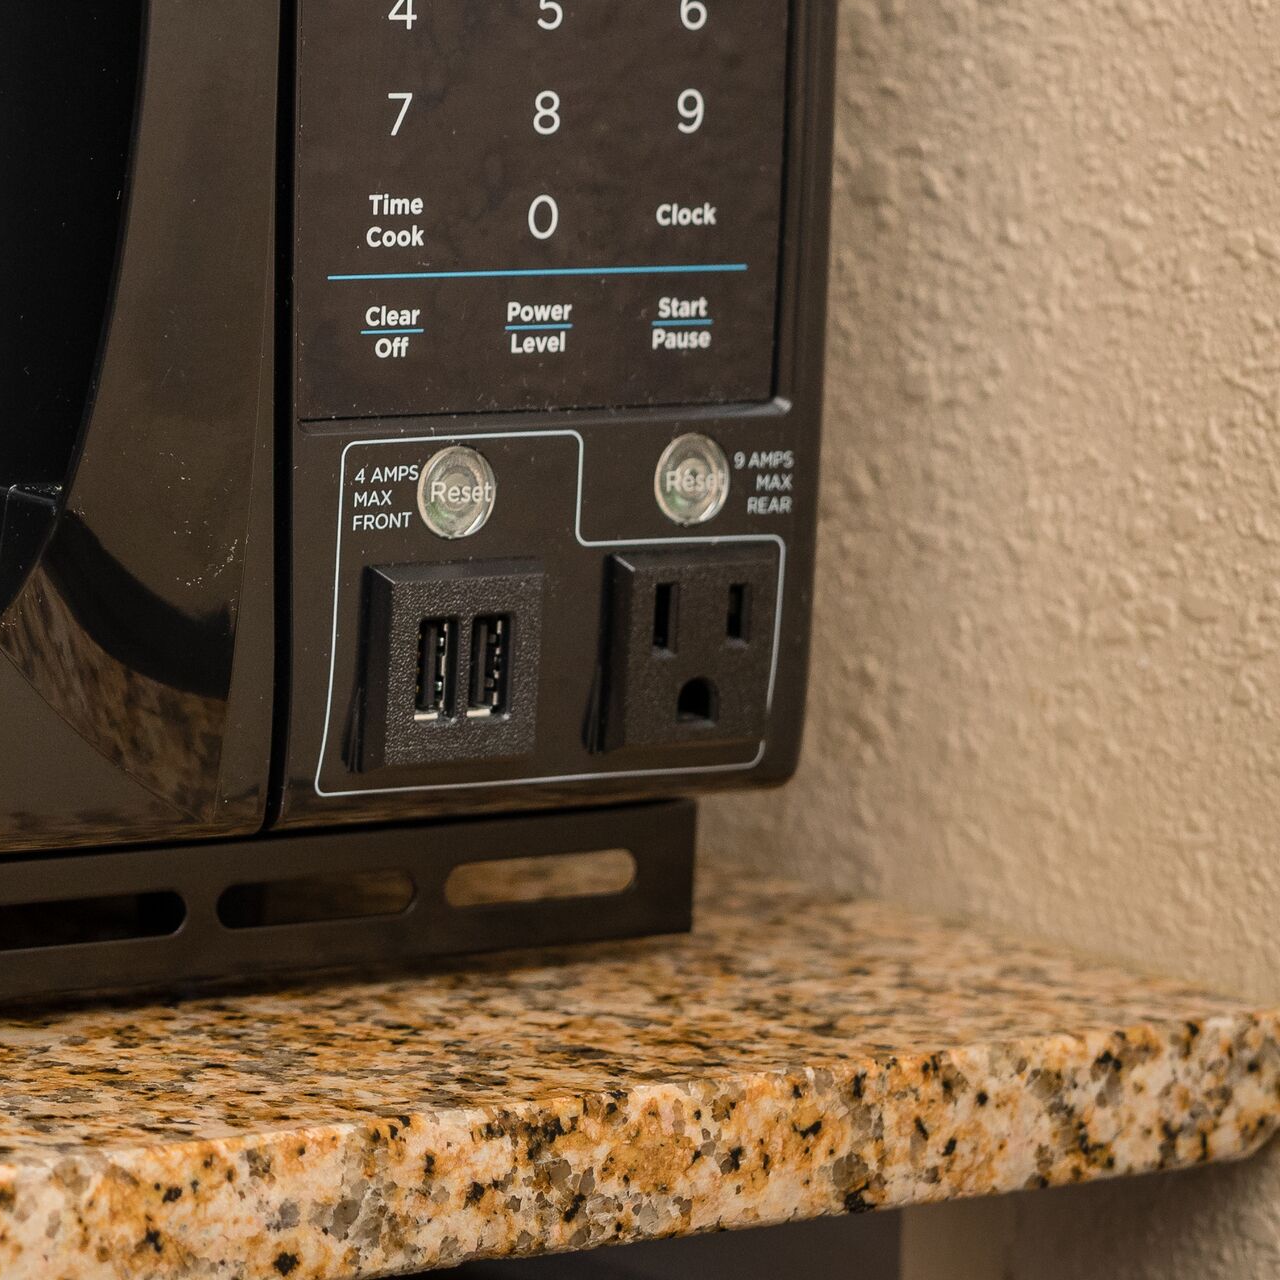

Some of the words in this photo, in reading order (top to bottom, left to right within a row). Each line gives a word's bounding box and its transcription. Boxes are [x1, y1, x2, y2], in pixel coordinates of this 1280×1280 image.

[388, 93, 412, 136] 7
[533, 91, 561, 134] 8
[676, 89, 705, 133] 9
[369, 194, 424, 215] Time
[656, 203, 717, 225] Clock
[528, 195, 558, 239] 0
[366, 226, 424, 247] Cook
[365, 307, 421, 326] Clear
[506, 303, 572, 323] Power
[658, 297, 708, 318] Start
[374, 336, 409, 358] Off
[510, 332, 566, 353] Level
[651, 328, 712, 350] Pause
[734, 452, 745, 470] 9
[748, 451, 794, 469] AMPS
[354, 468, 365, 482] 4
[370, 466, 418, 482] AMPS
[665, 470, 725, 493] Reset
[756, 474, 793, 491] MAX
[353, 490, 391, 506] MAX
[430, 482, 491, 503] Reset
[747, 496, 792, 514] REAR
[352, 512, 412, 531] FRONT
